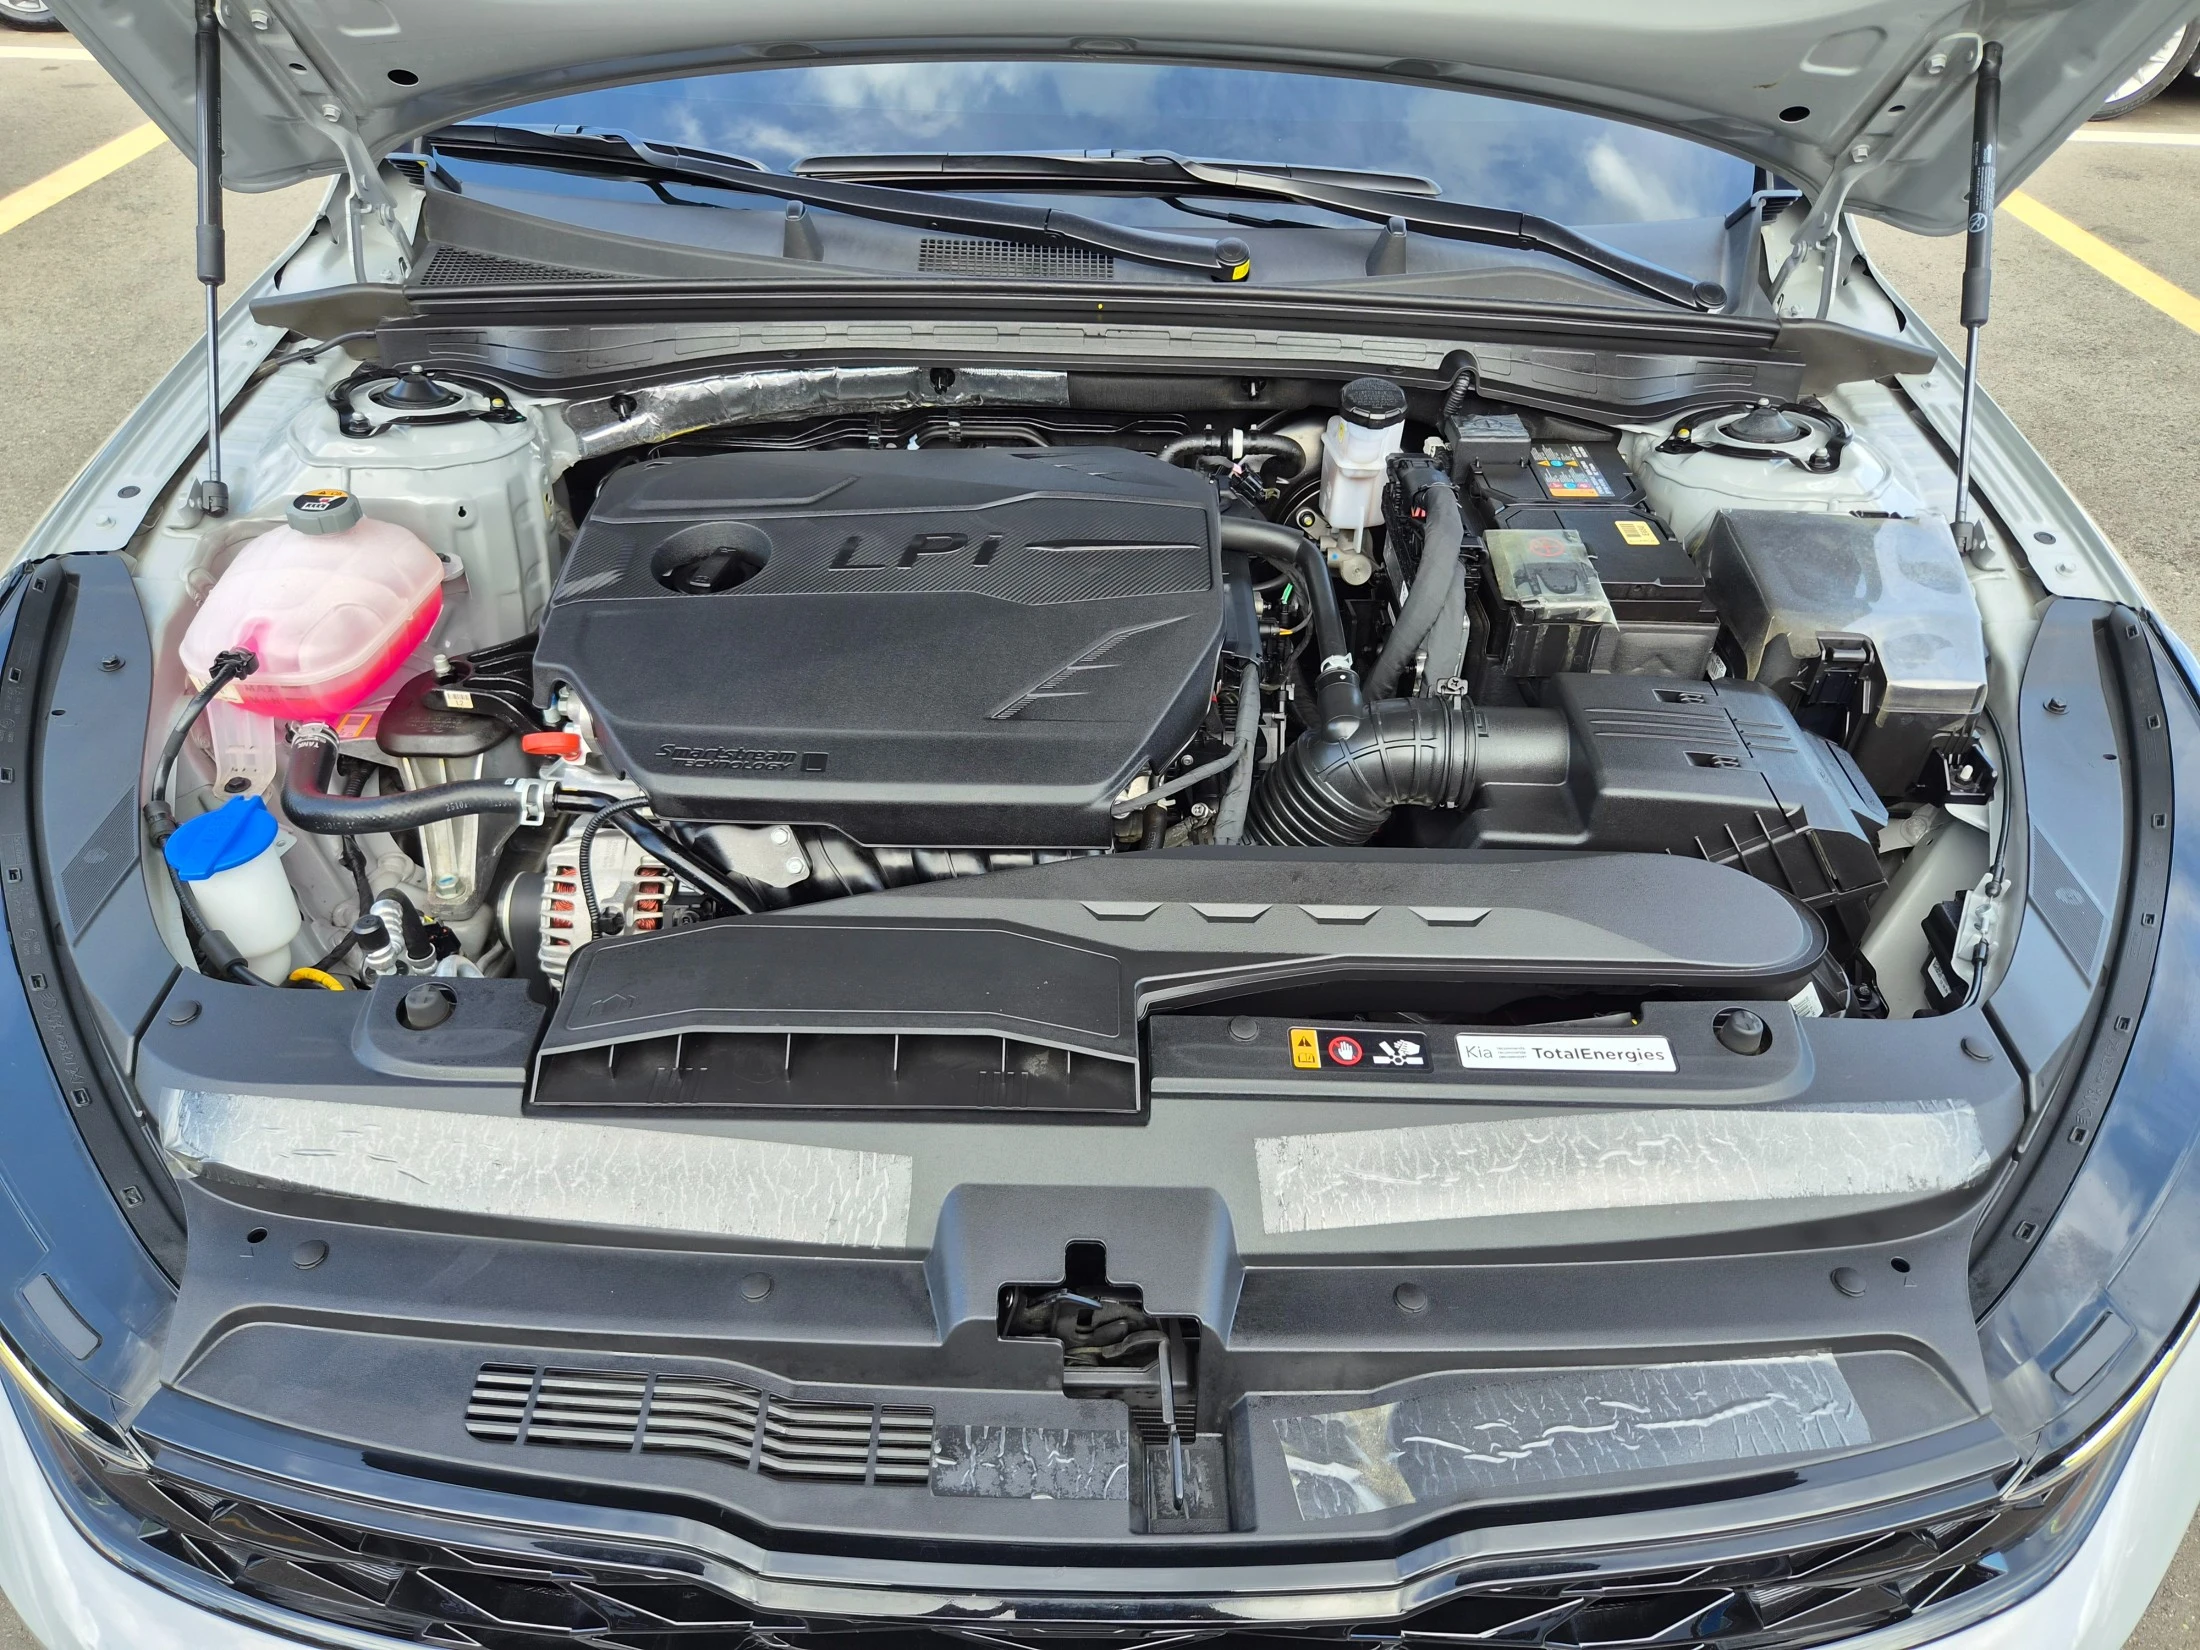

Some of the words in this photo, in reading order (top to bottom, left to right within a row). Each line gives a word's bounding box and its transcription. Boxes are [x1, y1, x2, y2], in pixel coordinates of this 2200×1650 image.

[655, 743, 797, 762] Smartstream
[672, 758, 794, 770] TECHNOLOGY
[1465, 1045, 1493, 1059] Kia
[1531, 1047, 1665, 1062] TotalEnergies
